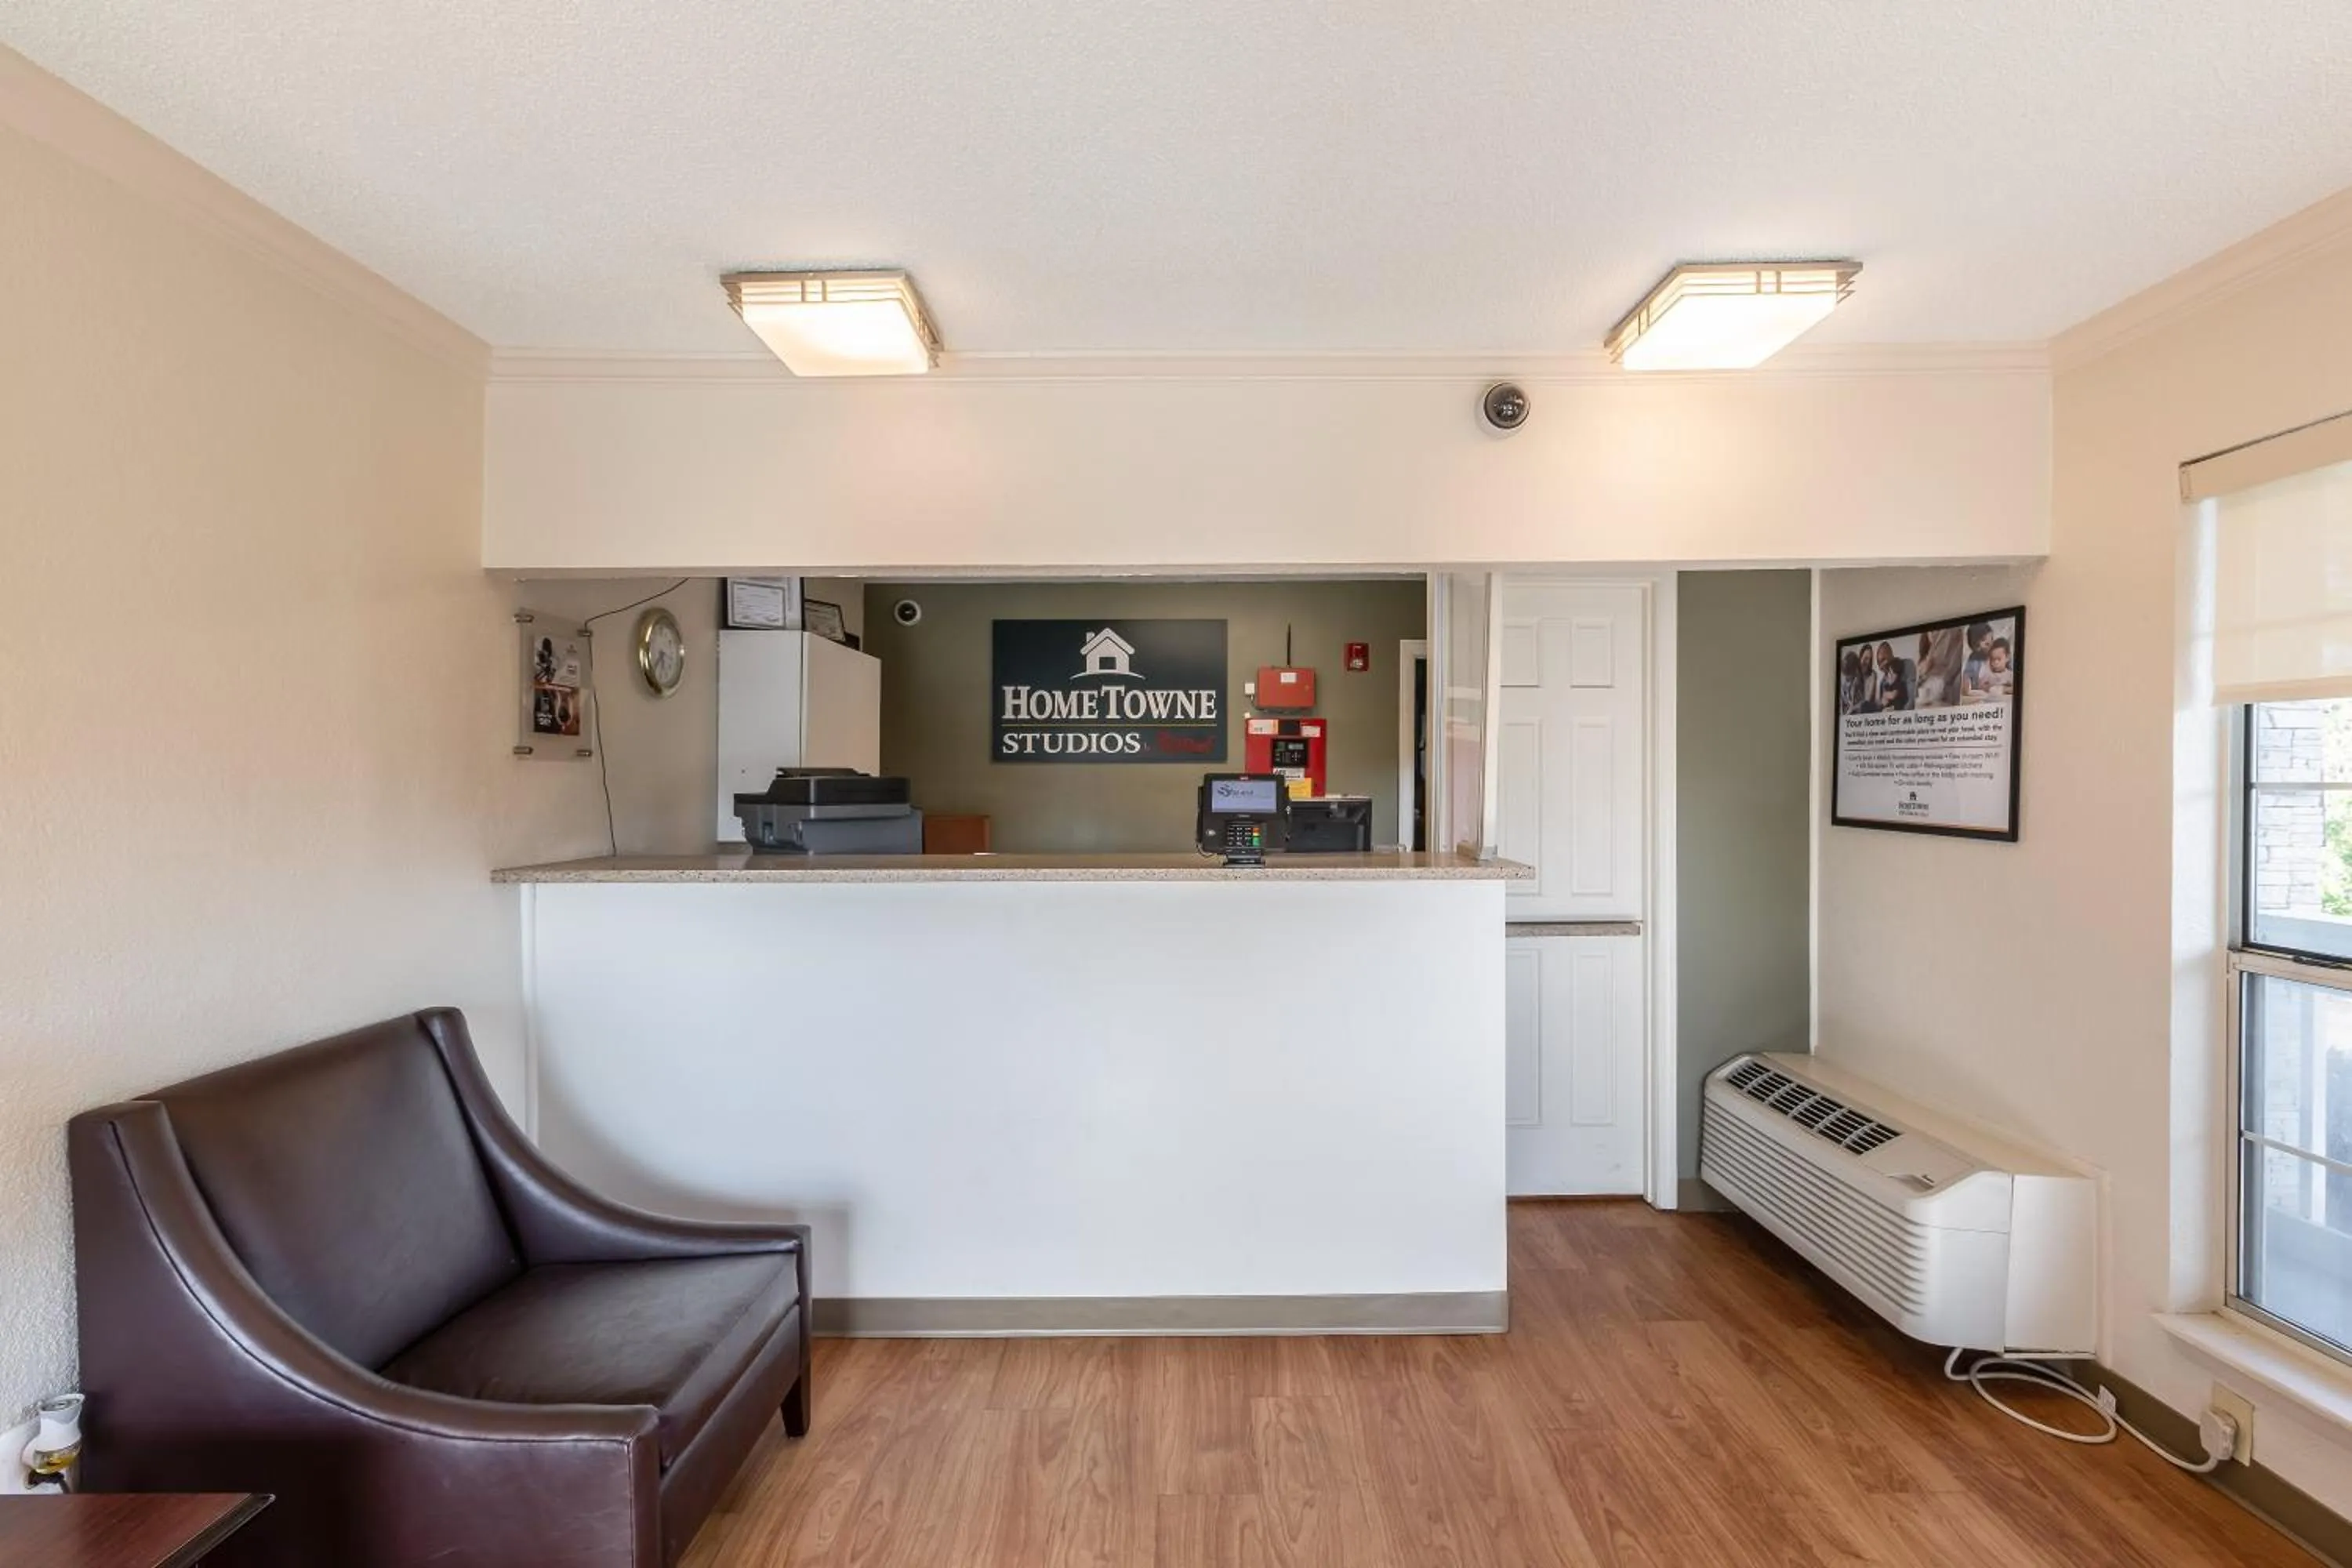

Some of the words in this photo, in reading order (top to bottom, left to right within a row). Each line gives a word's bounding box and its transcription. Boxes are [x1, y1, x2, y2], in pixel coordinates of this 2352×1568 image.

[1846, 718, 1862, 728] Your
[1864, 717, 1886, 727] home
[1888, 714, 1901, 725] for
[1915, 713, 1935, 726] long
[1951, 712, 1969, 724] you
[1972, 707, 2004, 720] need!
[1003, 733, 1141, 753] STUDIOS
